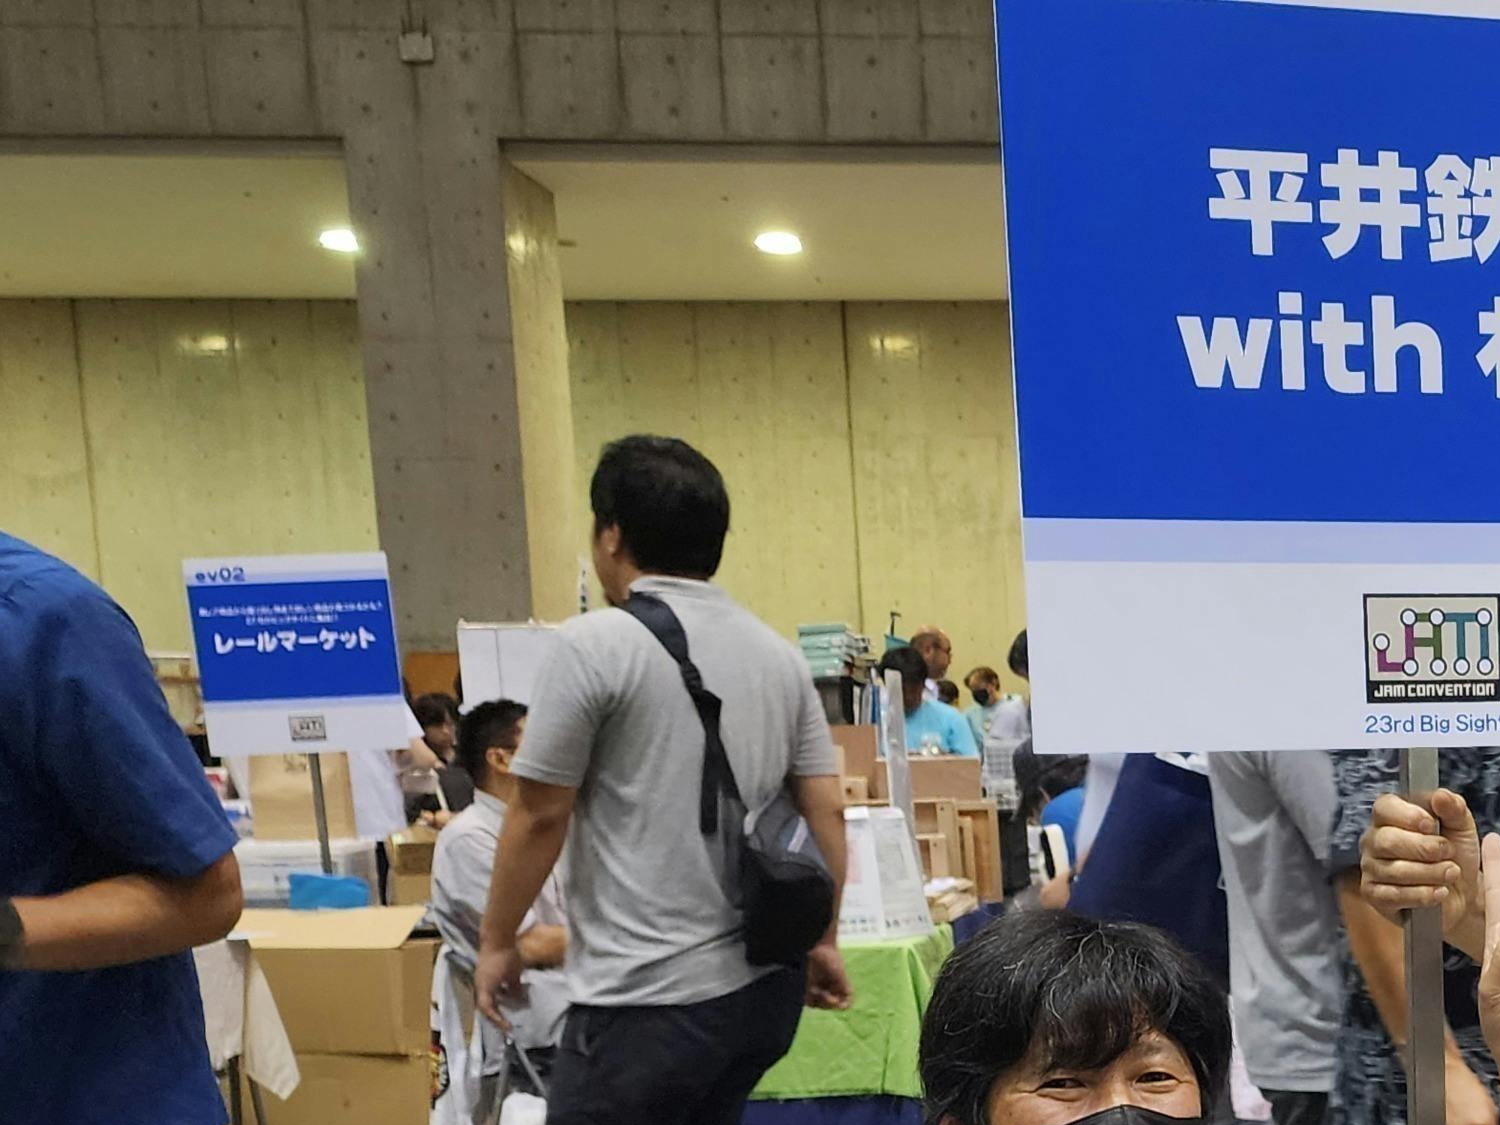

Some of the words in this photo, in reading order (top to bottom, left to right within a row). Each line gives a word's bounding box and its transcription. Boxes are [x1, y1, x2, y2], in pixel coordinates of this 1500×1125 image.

[1176, 291, 1443, 394] with
[195, 567, 246, 582] ev02
[213, 626, 376, 655] レールマーケット
[1374, 684, 1405, 697] JAM
[1407, 683, 1495, 697] CONVENTION
[1365, 715, 1414, 733] 23rd
[1420, 715, 1450, 733] Big
